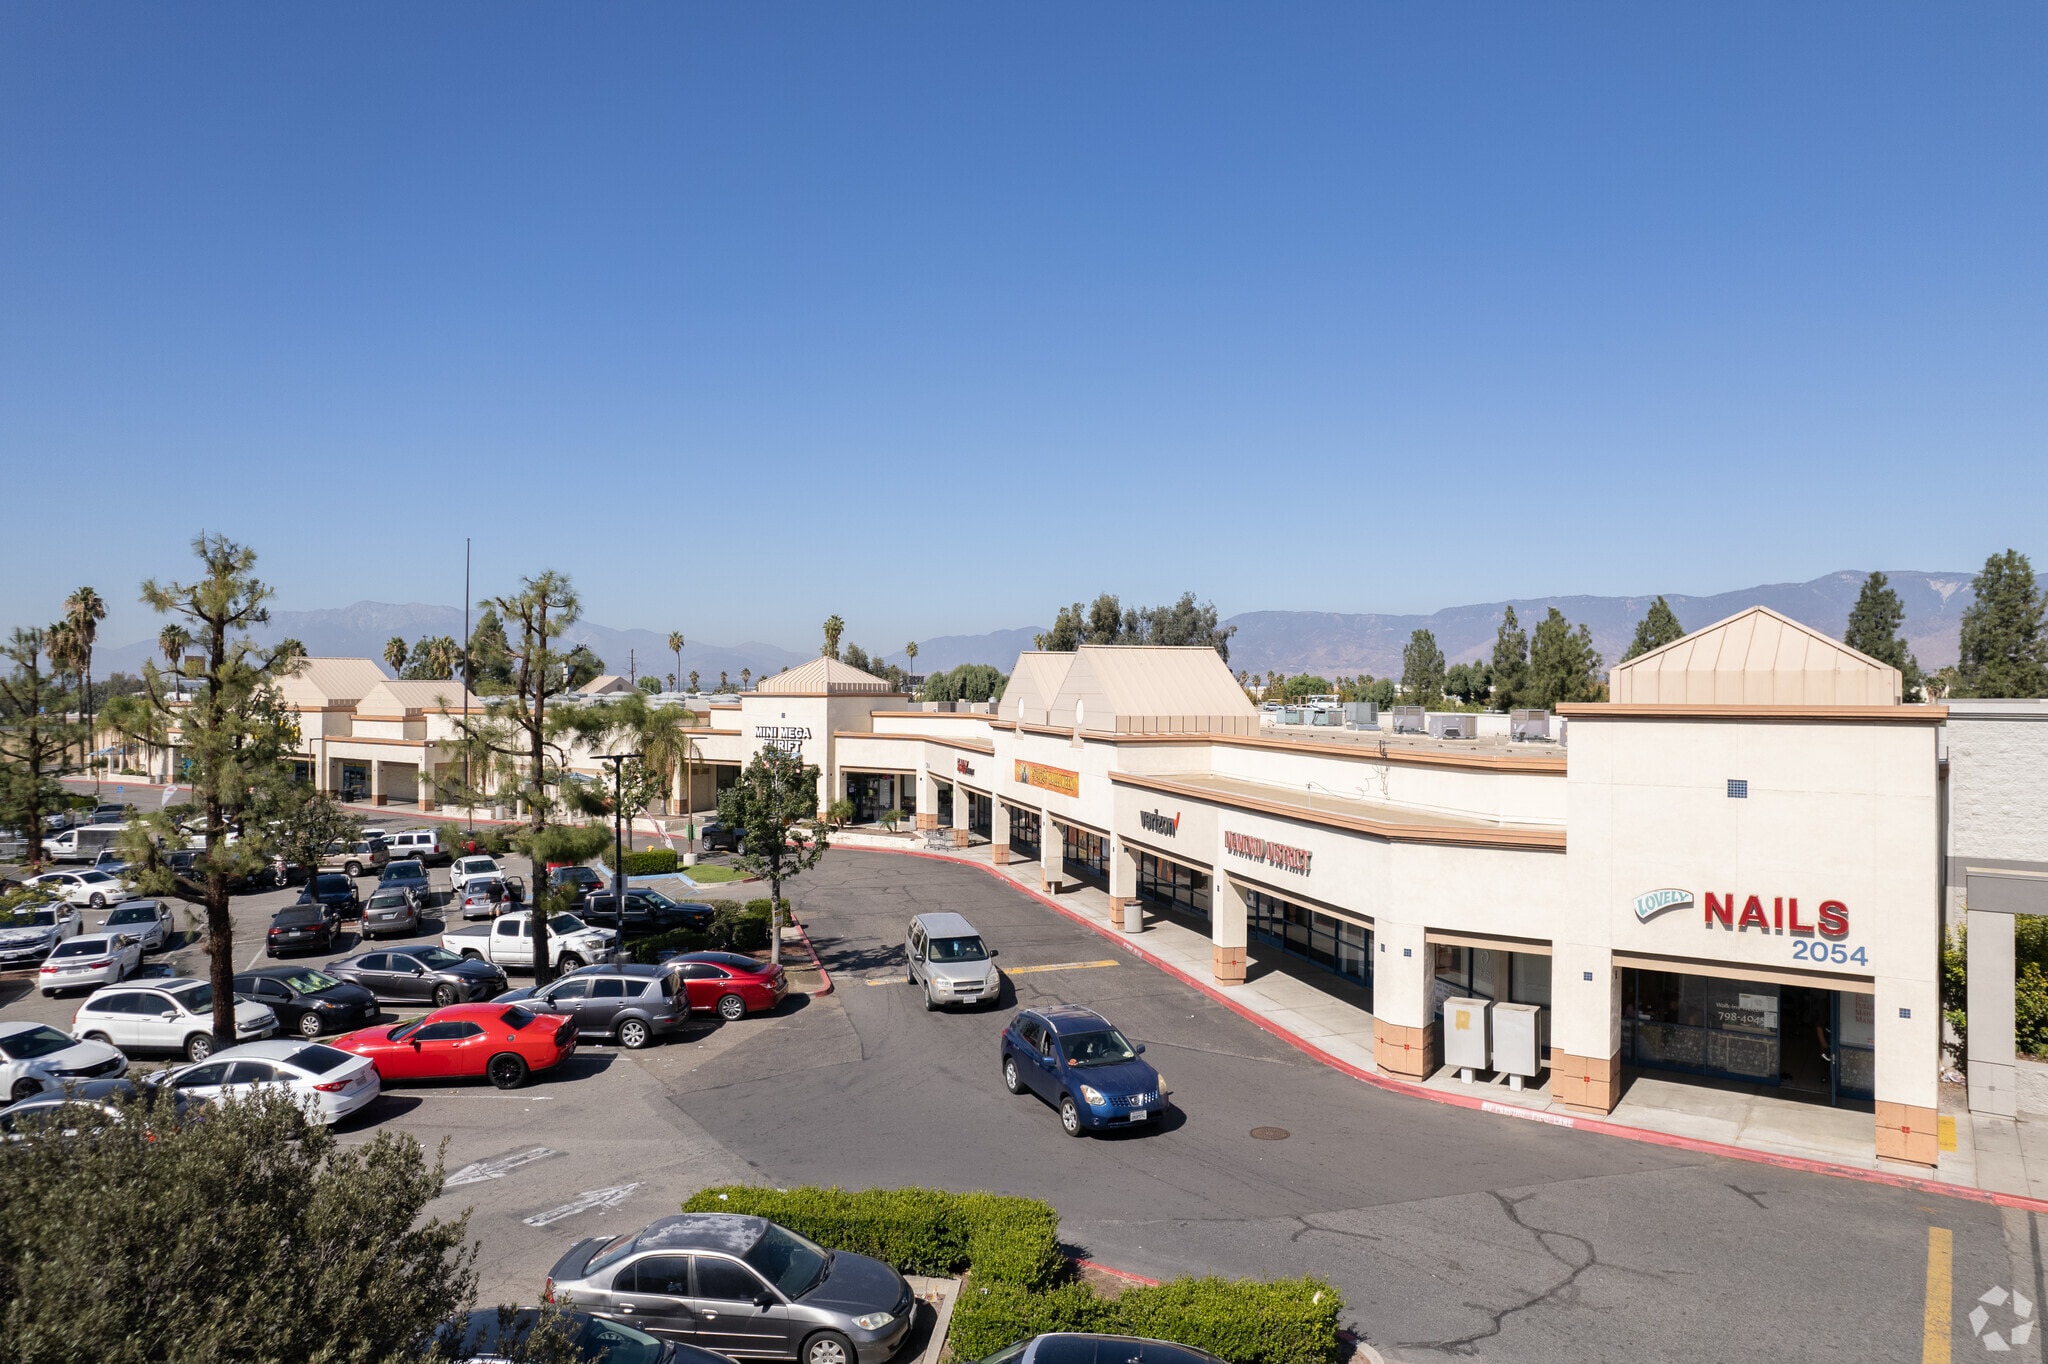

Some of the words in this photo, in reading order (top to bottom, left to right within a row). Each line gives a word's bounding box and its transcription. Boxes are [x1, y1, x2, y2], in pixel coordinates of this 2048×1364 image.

[754, 726, 778, 738] MINI
[780, 727, 812, 739] MEGA
[1140, 809, 1176, 838] verizon
[1225, 831, 1265, 858] DIAMOND
[1266, 842, 1311, 870] DISTRICT
[1637, 890, 1690, 915] LOVELY
[1704, 891, 1849, 936] NAILS
[1792, 940, 1868, 966] 2054
